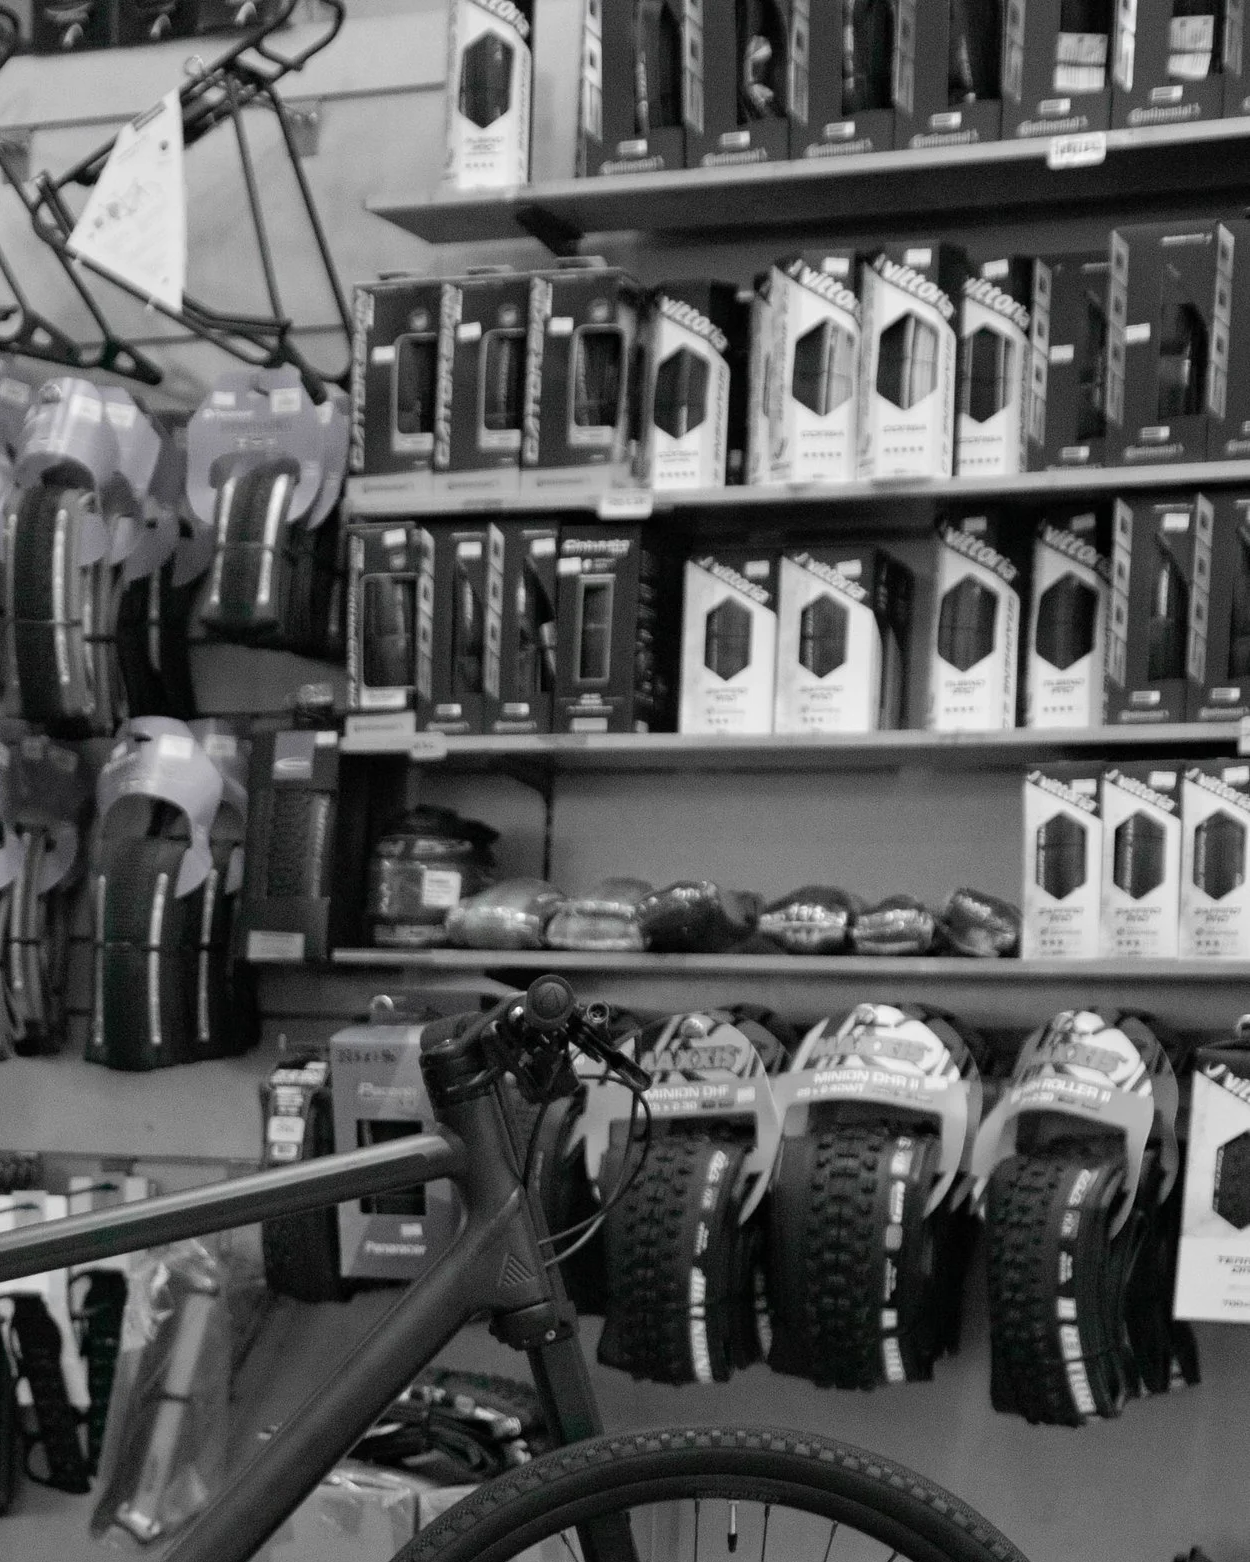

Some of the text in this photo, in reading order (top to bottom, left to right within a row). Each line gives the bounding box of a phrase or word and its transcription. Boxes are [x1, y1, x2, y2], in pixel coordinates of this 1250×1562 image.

[882, 260, 954, 321] vittoria
[659, 295, 729, 351] vittoria
[945, 526, 1017, 583] vittoria
[1118, 773, 1176, 812] vittoria
[644, 1083, 731, 1100] MINION DHF
[814, 1069, 870, 1084] MINION
[872, 1071, 908, 1088] DHR
[1041, 1077, 1101, 1099] ROLLER
